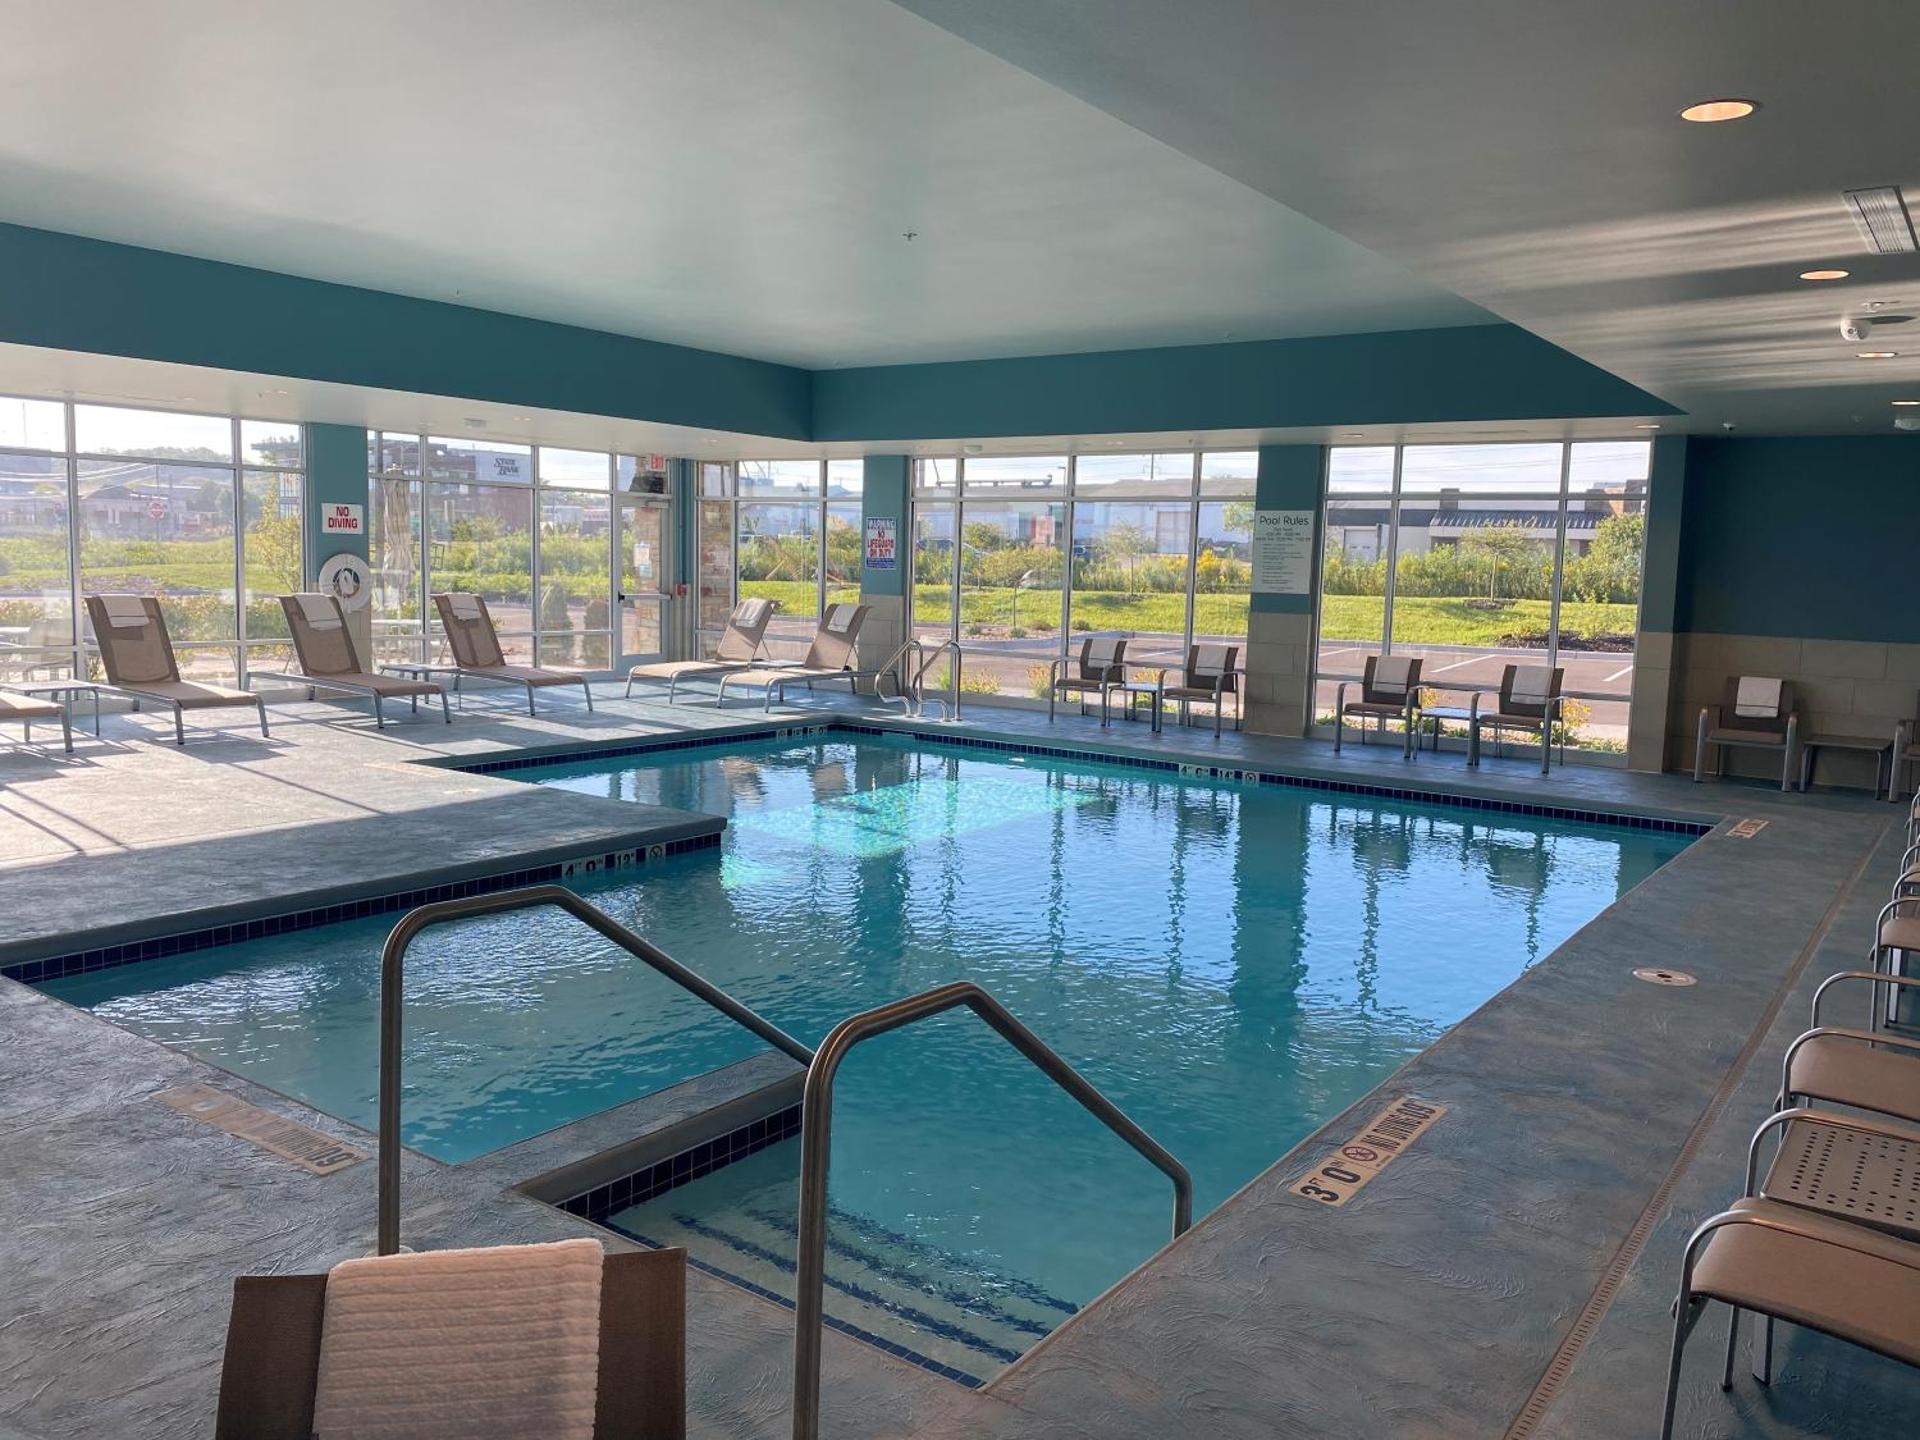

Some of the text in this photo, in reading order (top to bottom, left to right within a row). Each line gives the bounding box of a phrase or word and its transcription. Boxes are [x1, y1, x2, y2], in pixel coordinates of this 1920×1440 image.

[336, 506, 350, 517] NO
[328, 517, 358, 529] DIVING
[1260, 515, 1310, 526] Pool Rules
[867, 538, 894, 548] LIFEGUARD
[1371, 1114, 1422, 1141] DIVING
[1360, 1134, 1401, 1153] NO
[1321, 1166, 1361, 1184] 0
[1300, 1184, 1340, 1202] 3
